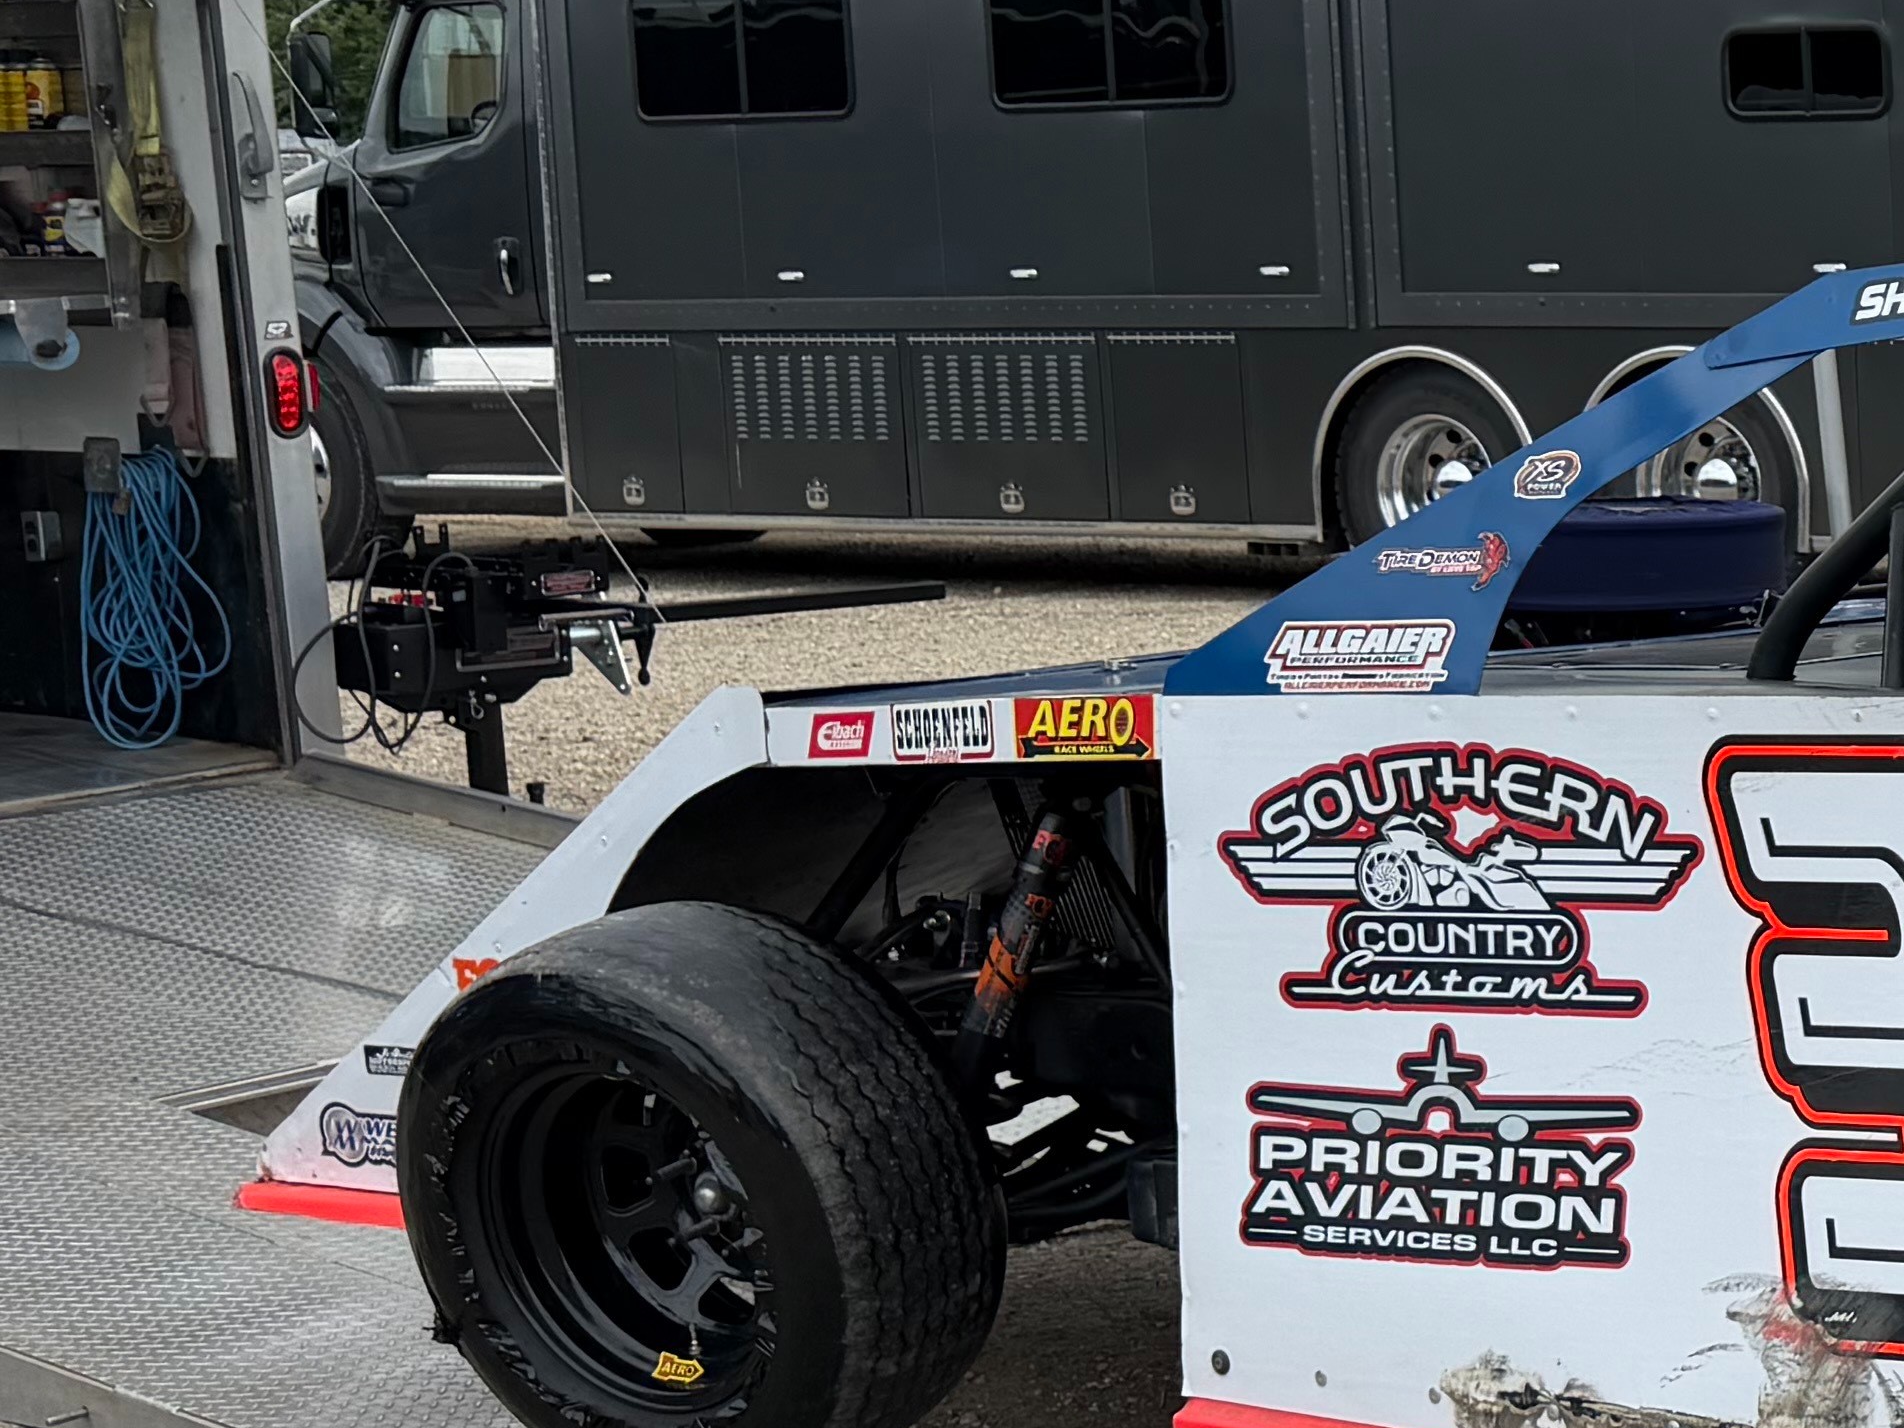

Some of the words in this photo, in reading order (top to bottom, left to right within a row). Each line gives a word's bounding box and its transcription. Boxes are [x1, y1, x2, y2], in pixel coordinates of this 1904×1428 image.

[1523, 459, 1566, 484] XS
[1275, 627, 1449, 655] ALLGAIER
[1289, 655, 1419, 664] PERFORMANCE
[895, 704, 990, 750] SCHOENFELD
[1027, 697, 1134, 748] AERO
[1260, 756, 1656, 862] SOUTHERN
[1357, 920, 1562, 957] COUNTRY
[1331, 948, 1590, 1002] Customs
[1260, 1134, 1623, 1187] PRIORITY
[1250, 1179, 1616, 1234] AVIATION
[1303, 1223, 1477, 1253] SERVICES
[1489, 1236, 1559, 1258] LLC
[660, 1361, 695, 1376] AERO
